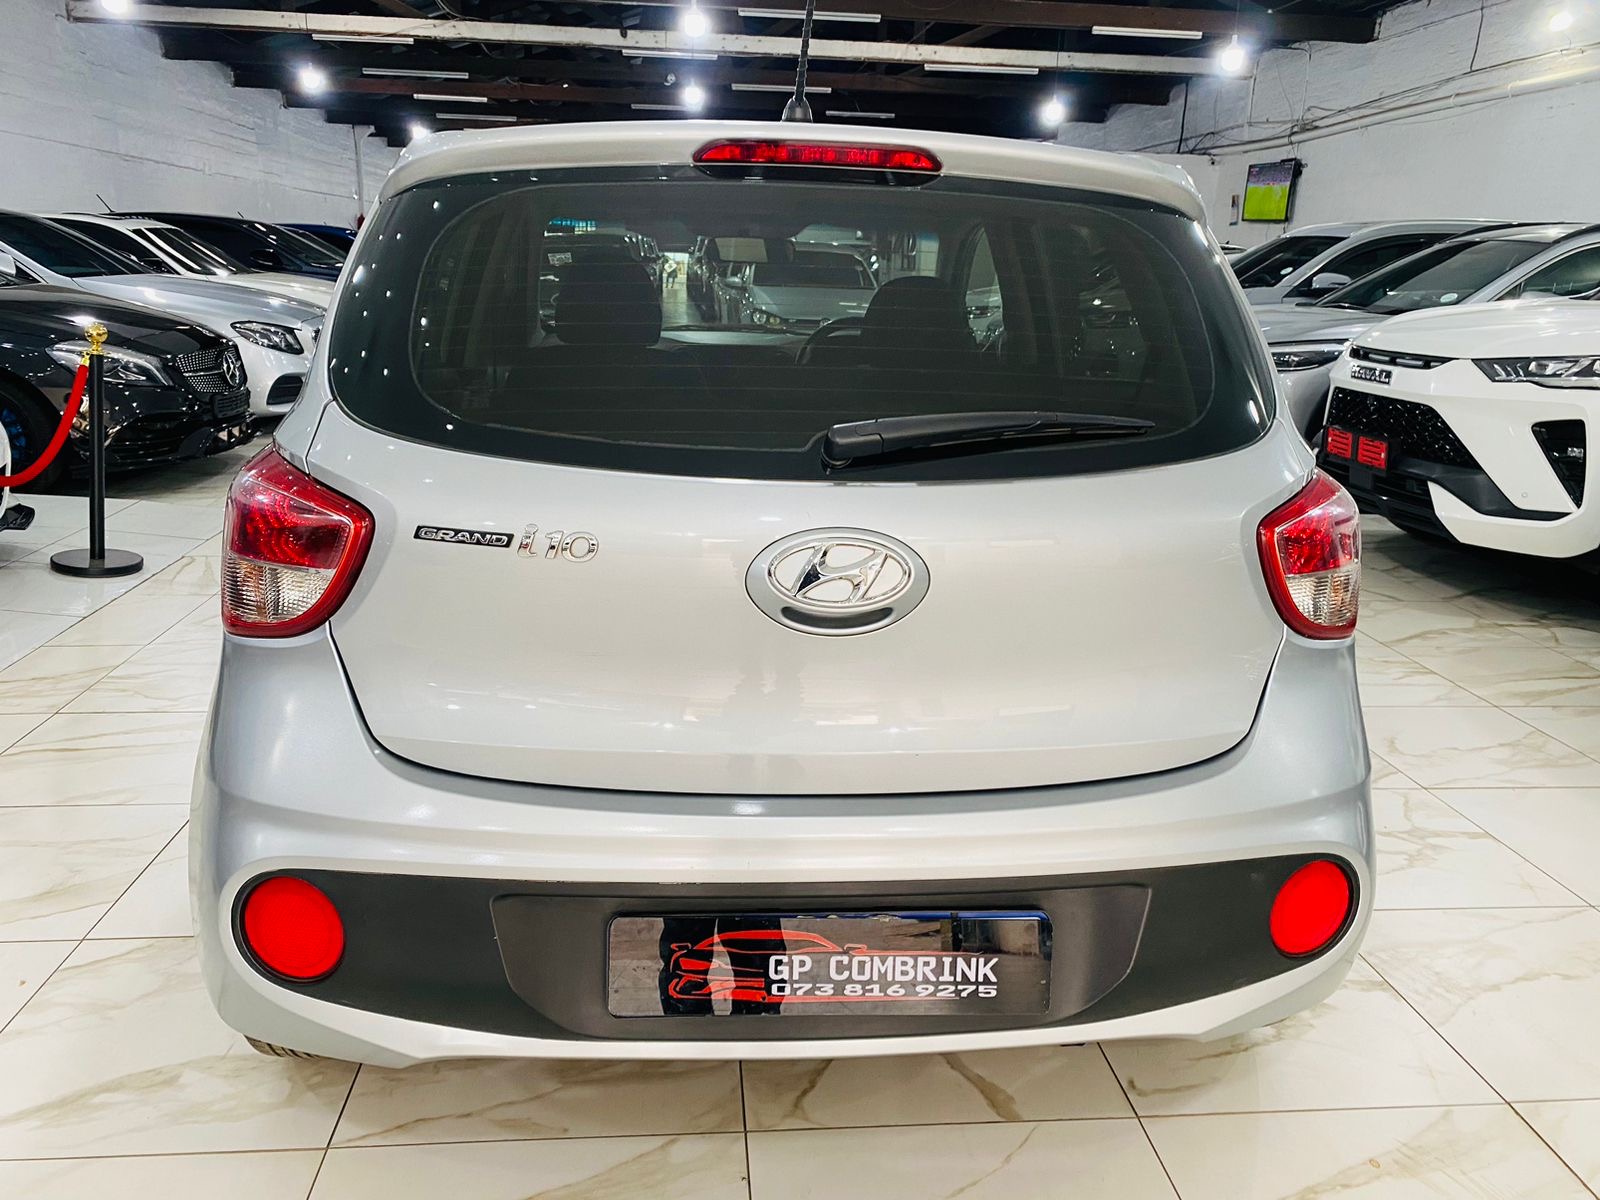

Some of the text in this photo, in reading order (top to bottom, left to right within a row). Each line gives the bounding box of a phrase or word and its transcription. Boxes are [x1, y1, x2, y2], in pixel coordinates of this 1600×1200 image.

[417, 523, 599, 563] GRAND i10
[768, 955, 999, 983] GP COMBRINK
[771, 983, 998, 998] 073 816 9275
